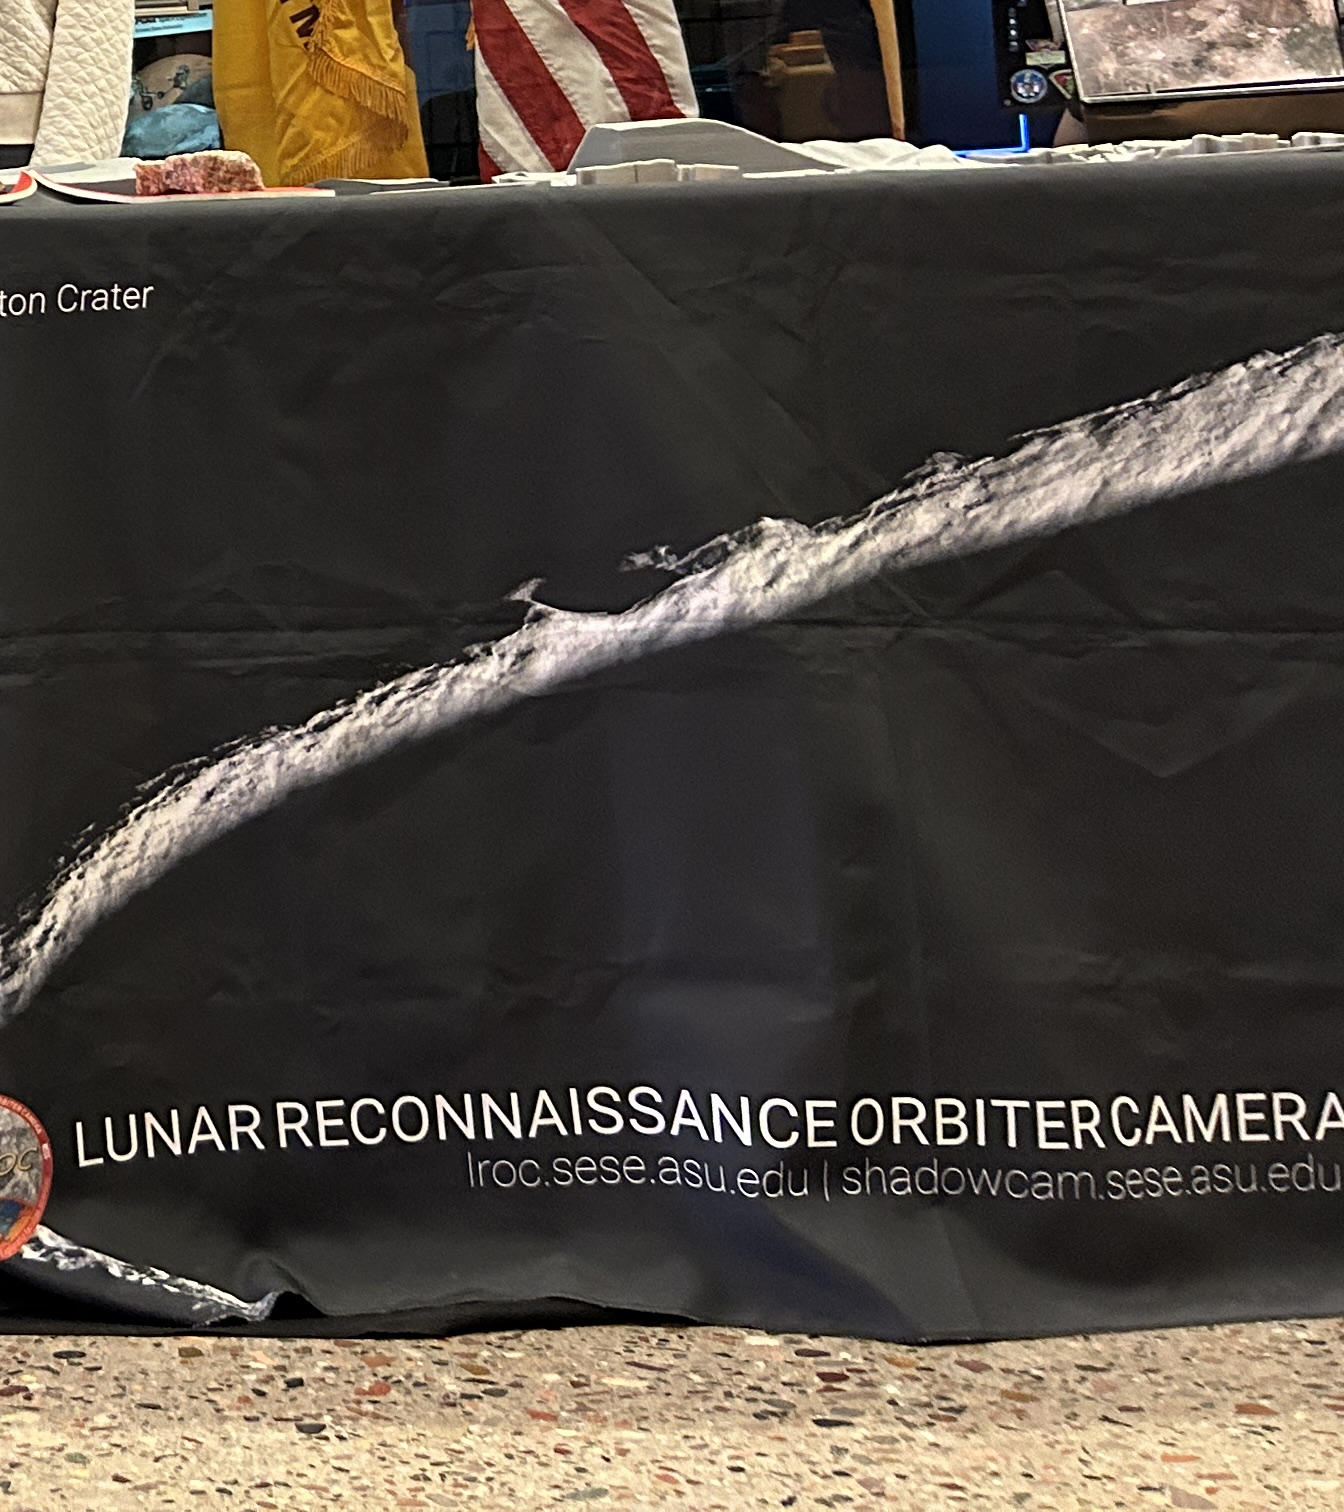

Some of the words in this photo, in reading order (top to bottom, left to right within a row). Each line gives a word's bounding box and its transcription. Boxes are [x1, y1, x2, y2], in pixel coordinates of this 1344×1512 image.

[57, 284, 154, 313] Crater
[75, 1103, 267, 1170] LUNAR
[278, 1085, 839, 1150] RECONNAISSANCE
[850, 1096, 1107, 1151] ORBITER
[1110, 1091, 1344, 1147] CAMERA
[467, 1149, 810, 1199] lroc.sese.asu.edu
[842, 1154, 1344, 1203] shadowcam.sese.asu.edu
